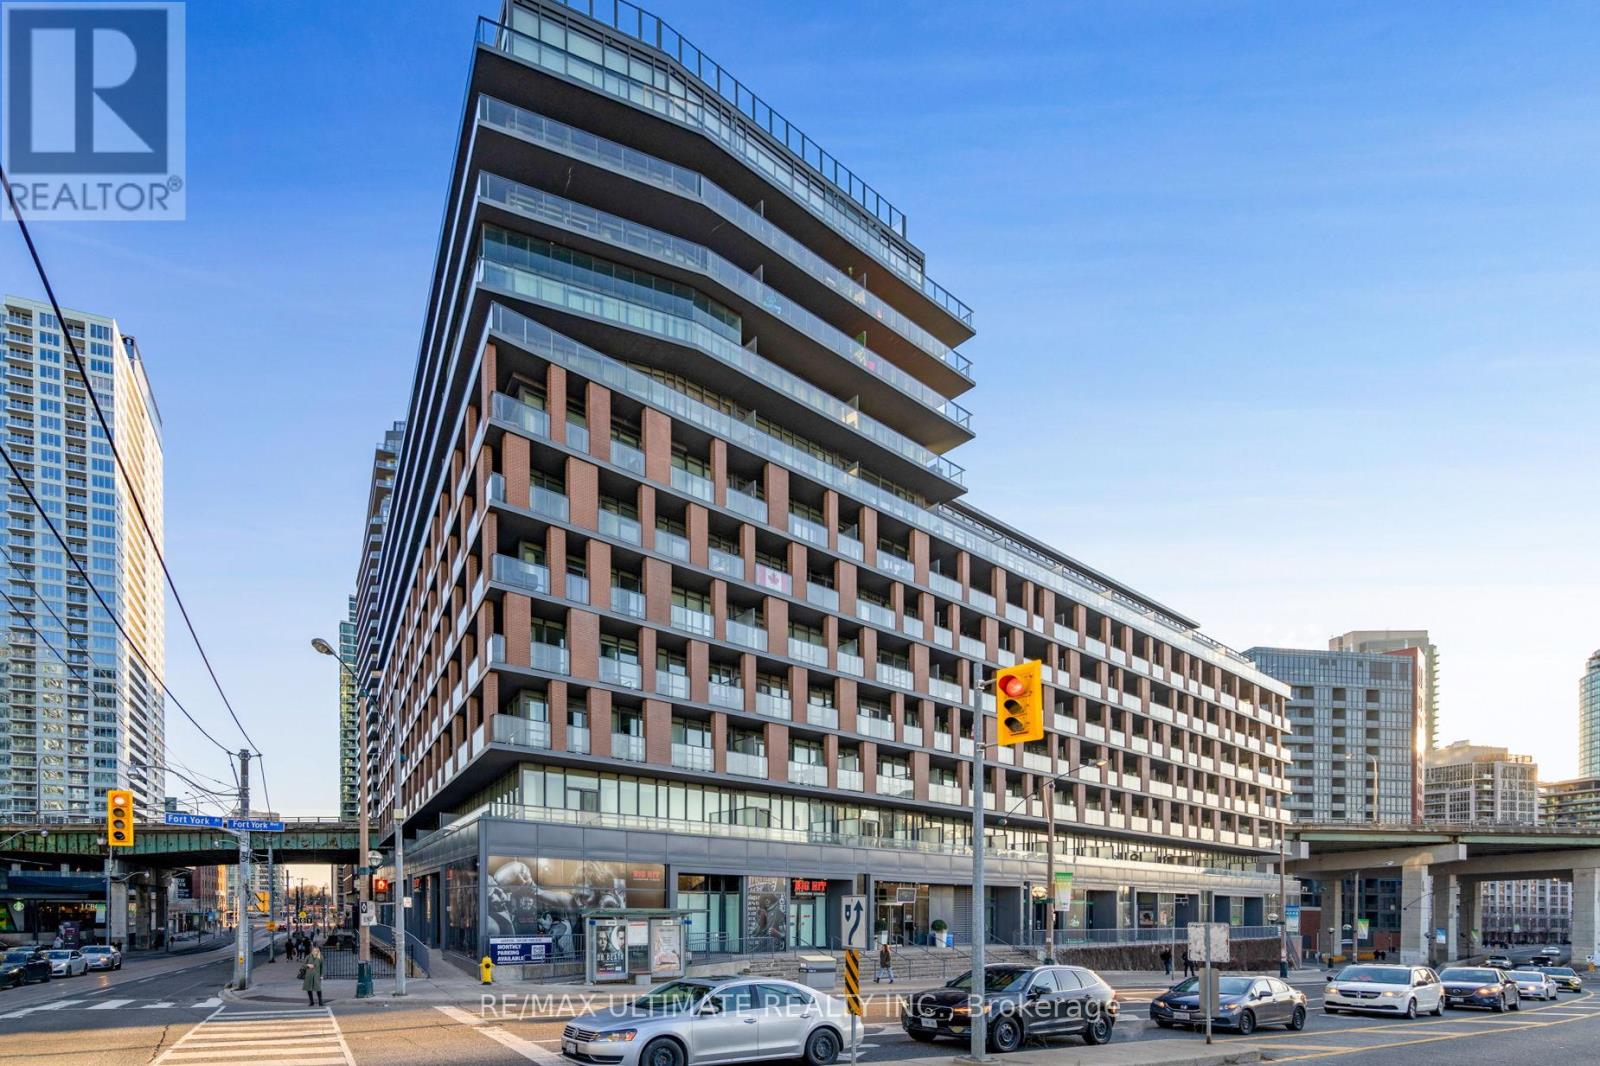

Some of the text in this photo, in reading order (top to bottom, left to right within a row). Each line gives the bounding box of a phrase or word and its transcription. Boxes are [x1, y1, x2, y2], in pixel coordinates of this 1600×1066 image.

[168, 814, 187, 824] Fort
[189, 816, 210, 825] York
[232, 821, 250, 829] Fort
[811, 881, 827, 891] HIT
